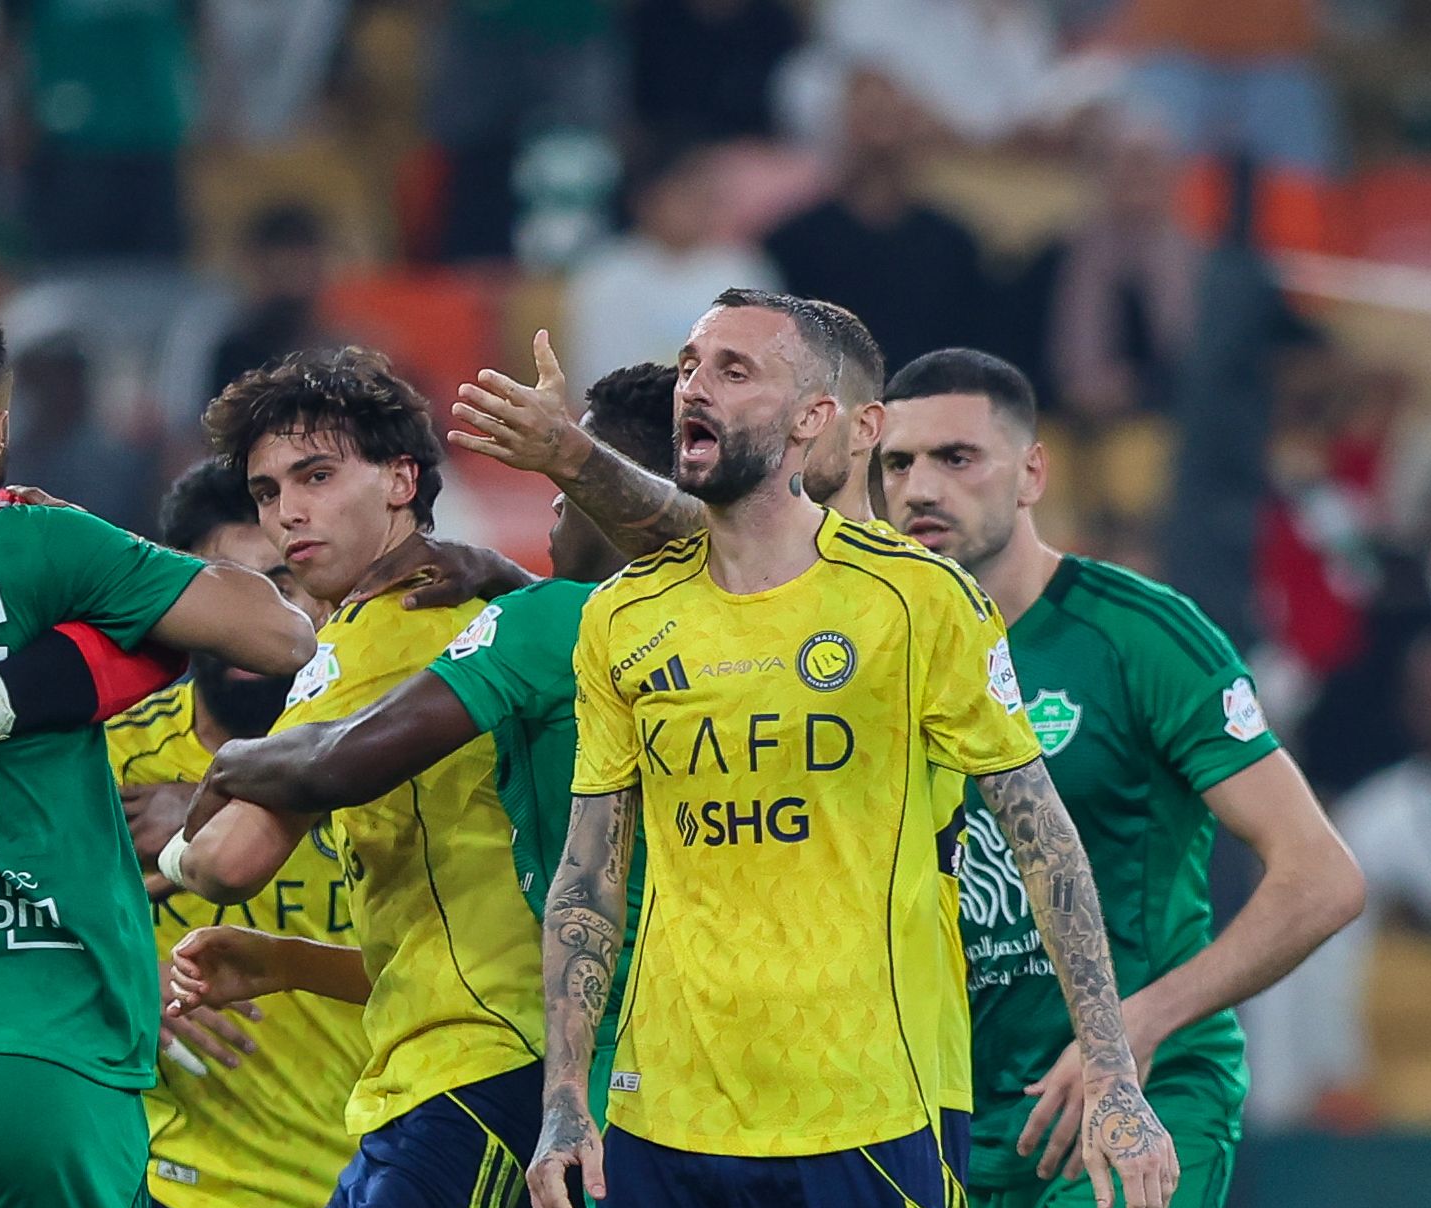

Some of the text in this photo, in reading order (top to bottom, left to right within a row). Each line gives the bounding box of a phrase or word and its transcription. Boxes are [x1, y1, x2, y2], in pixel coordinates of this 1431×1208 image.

[611, 618, 678, 683] Gathern
[640, 712, 856, 778] KAFD
[703, 796, 810, 848] SHG
